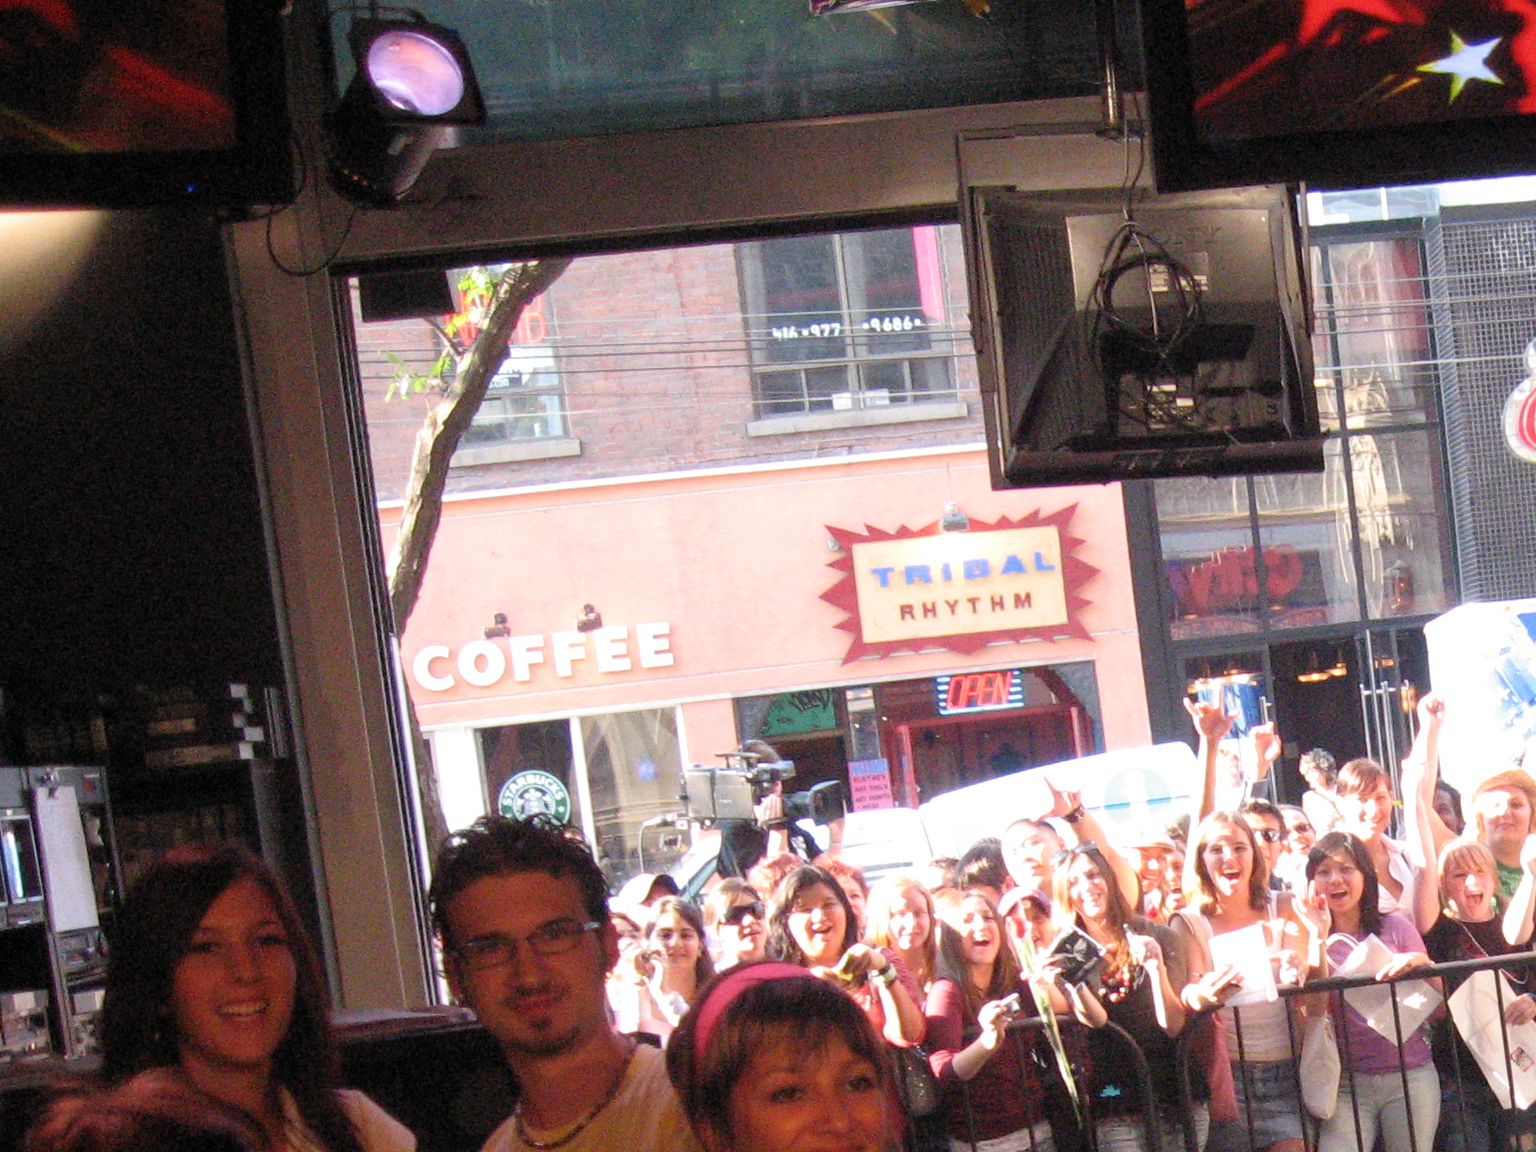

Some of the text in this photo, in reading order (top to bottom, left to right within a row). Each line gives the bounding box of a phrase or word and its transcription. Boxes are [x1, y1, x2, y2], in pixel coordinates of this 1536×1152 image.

[870, 550, 1056, 588] TRIBAL
[899, 591, 1033, 622] RHYTHM
[412, 621, 675, 692] COFFEE
[945, 671, 1014, 711] OPEN
[502, 773, 566, 808] STARBUCKS
